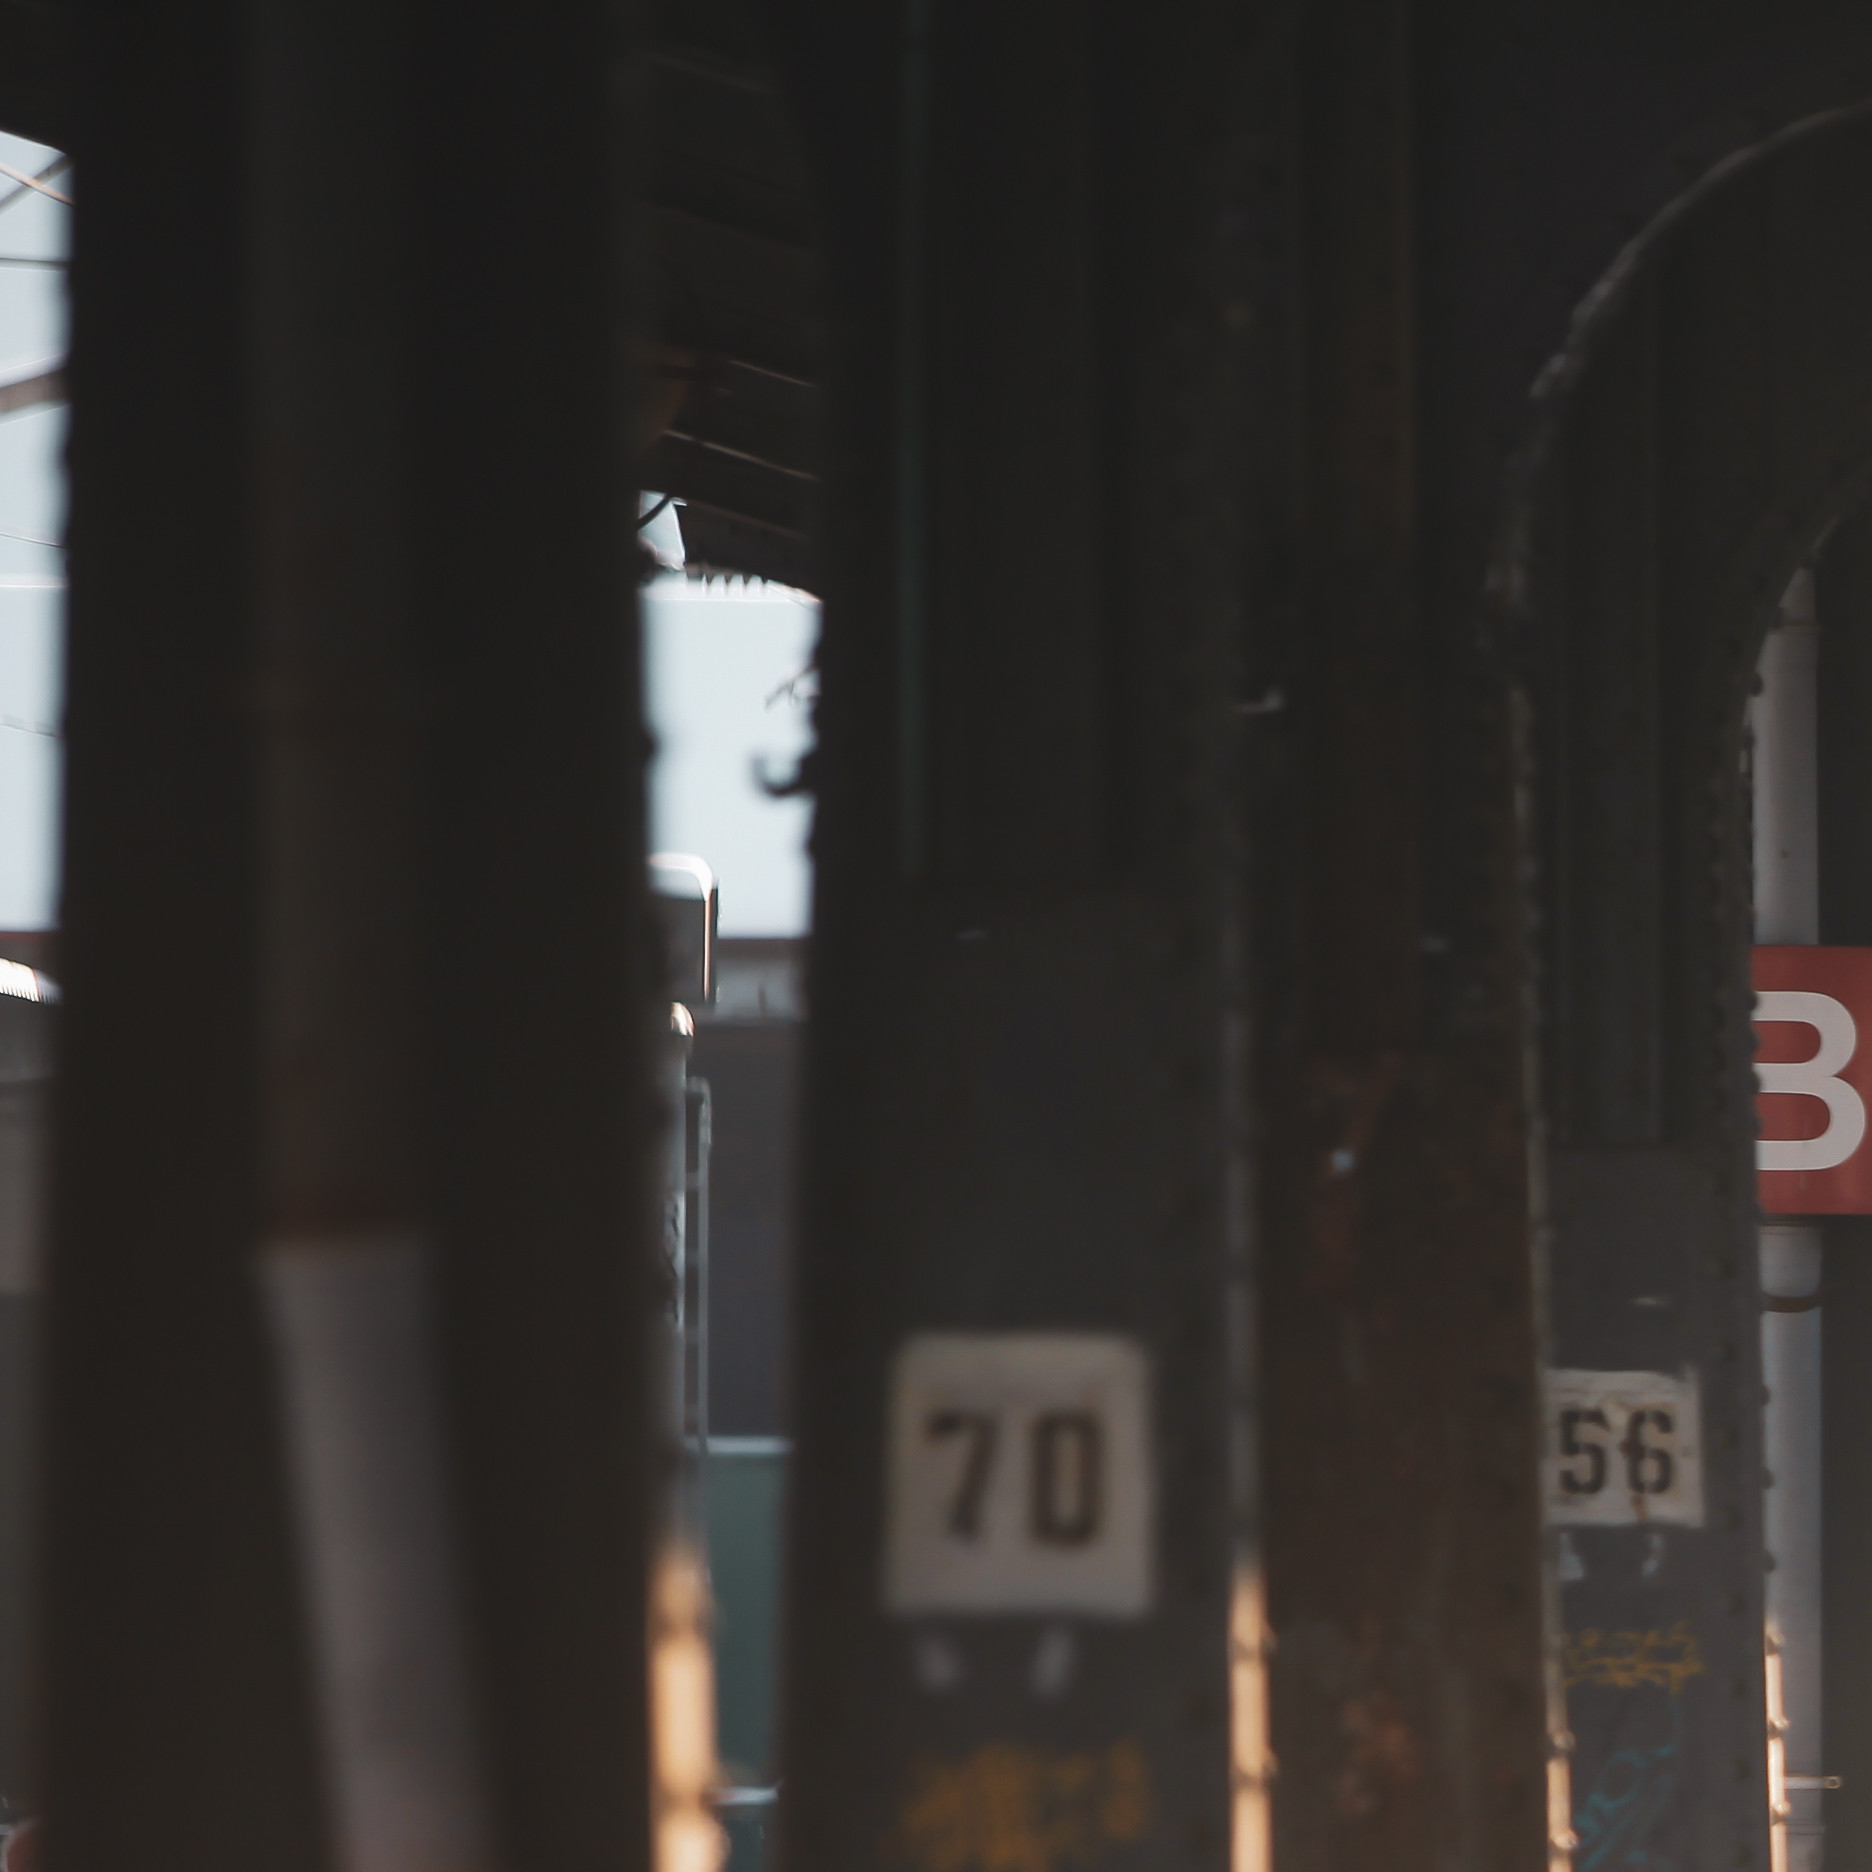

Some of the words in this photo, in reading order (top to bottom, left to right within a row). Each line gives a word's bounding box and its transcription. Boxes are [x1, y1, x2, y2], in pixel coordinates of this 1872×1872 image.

[1751, 990, 1867, 1171] B
[924, 1408, 1110, 1550] 70
[1558, 1407, 1676, 1496] 56
